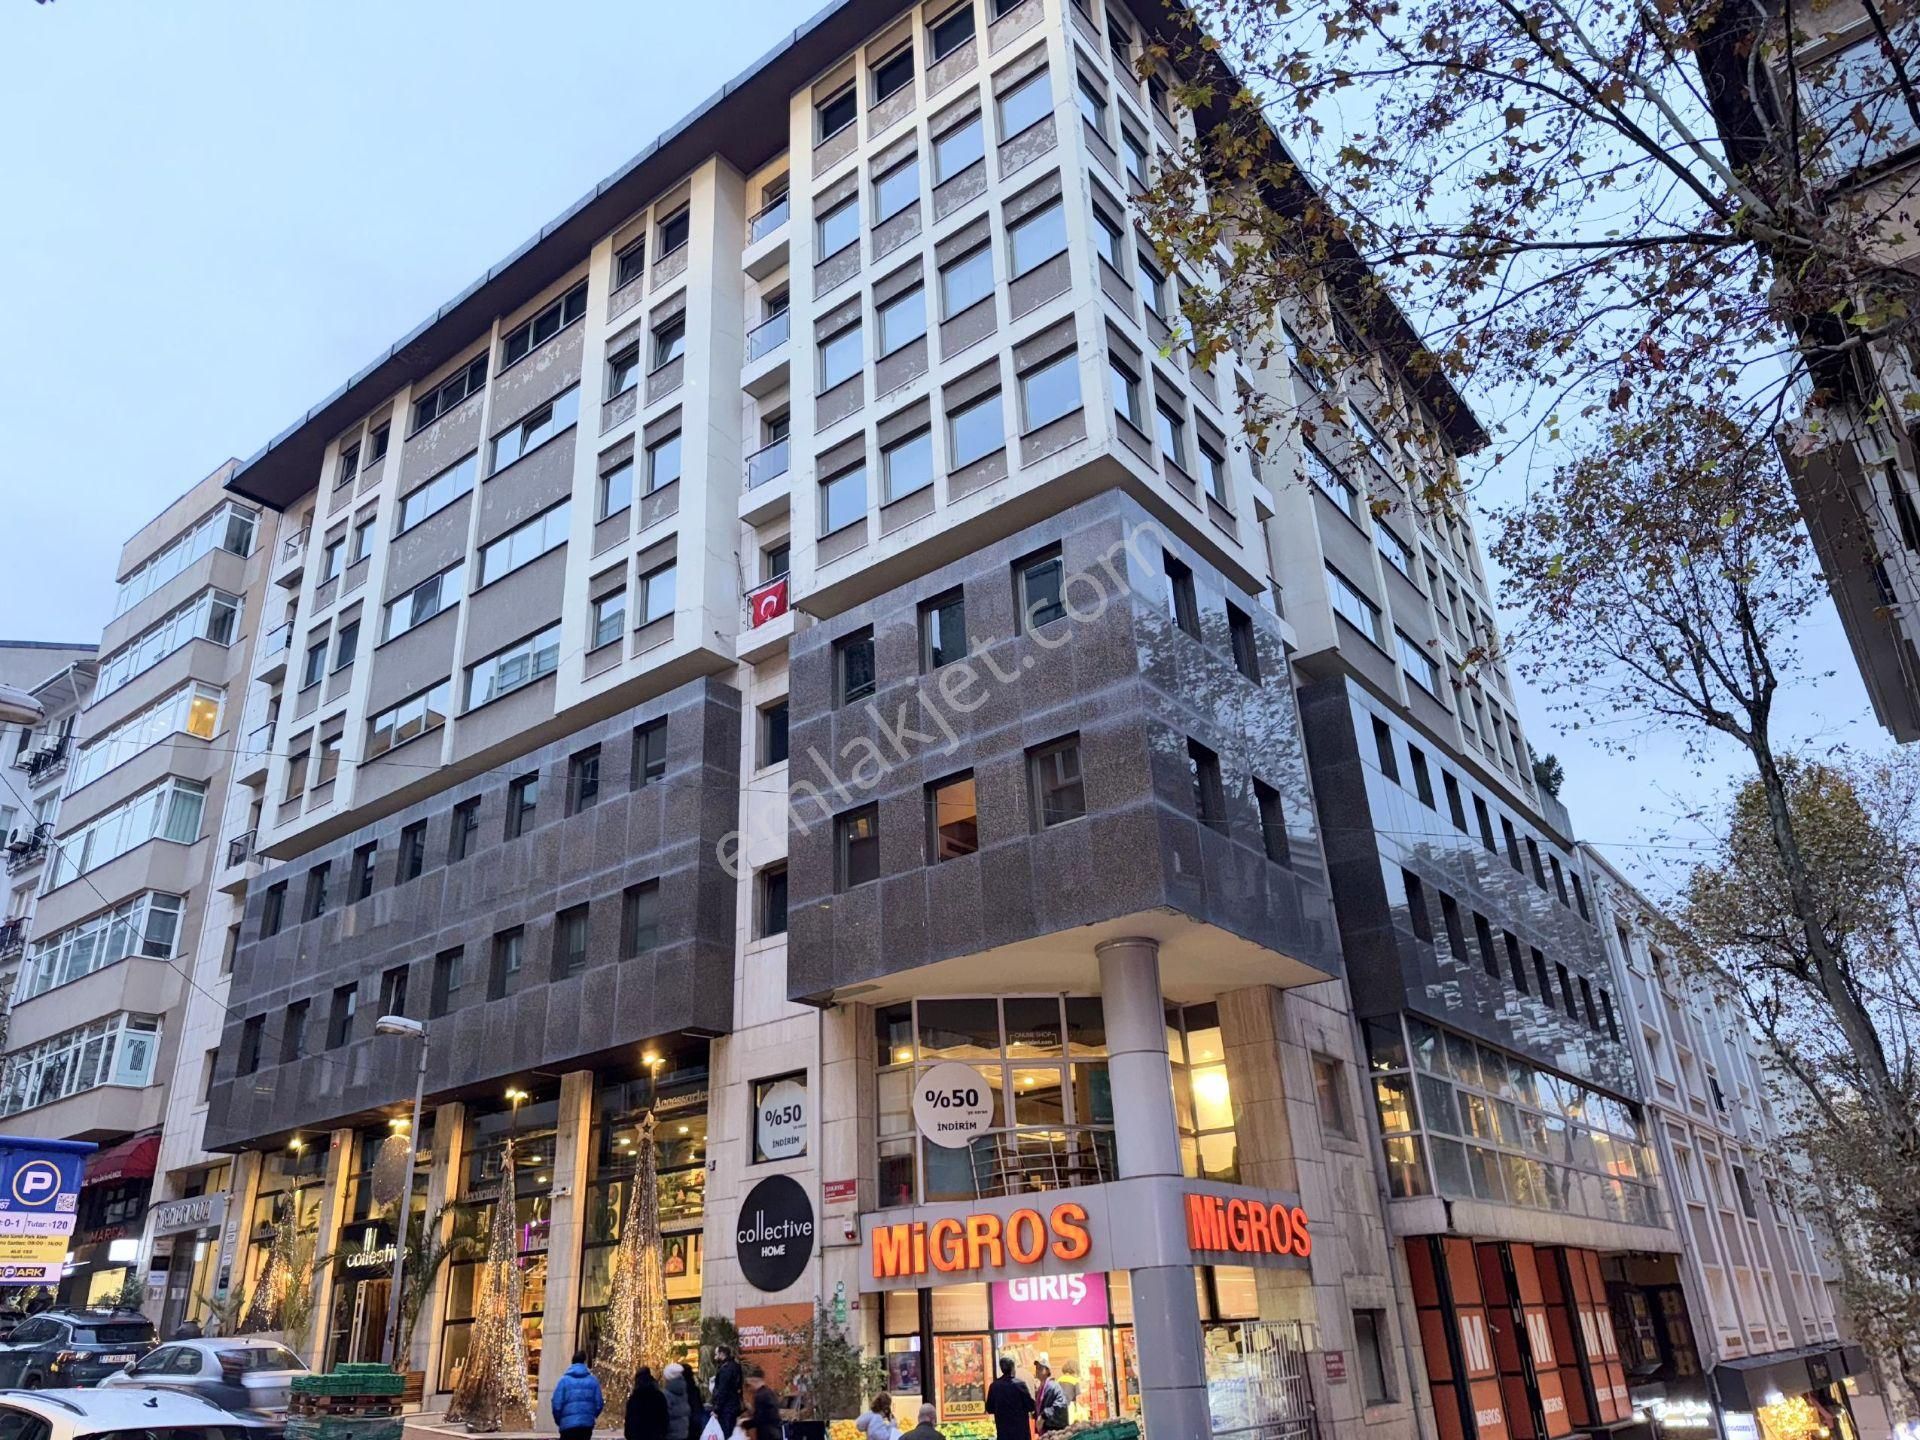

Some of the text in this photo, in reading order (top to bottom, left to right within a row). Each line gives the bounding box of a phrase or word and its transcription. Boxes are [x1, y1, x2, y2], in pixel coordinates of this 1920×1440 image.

[765, 1103, 802, 1128] %50
[924, 1088, 979, 1109] %50
[937, 1120, 977, 1132] İNDİRİM
[737, 1209, 812, 1244] collective
[761, 1244, 786, 1258] HOME
[1461, 1315, 1490, 1372] M
[1526, 1313, 1553, 1364] M
[1579, 1311, 1601, 1357] M
[1596, 1311, 1618, 1355] M
